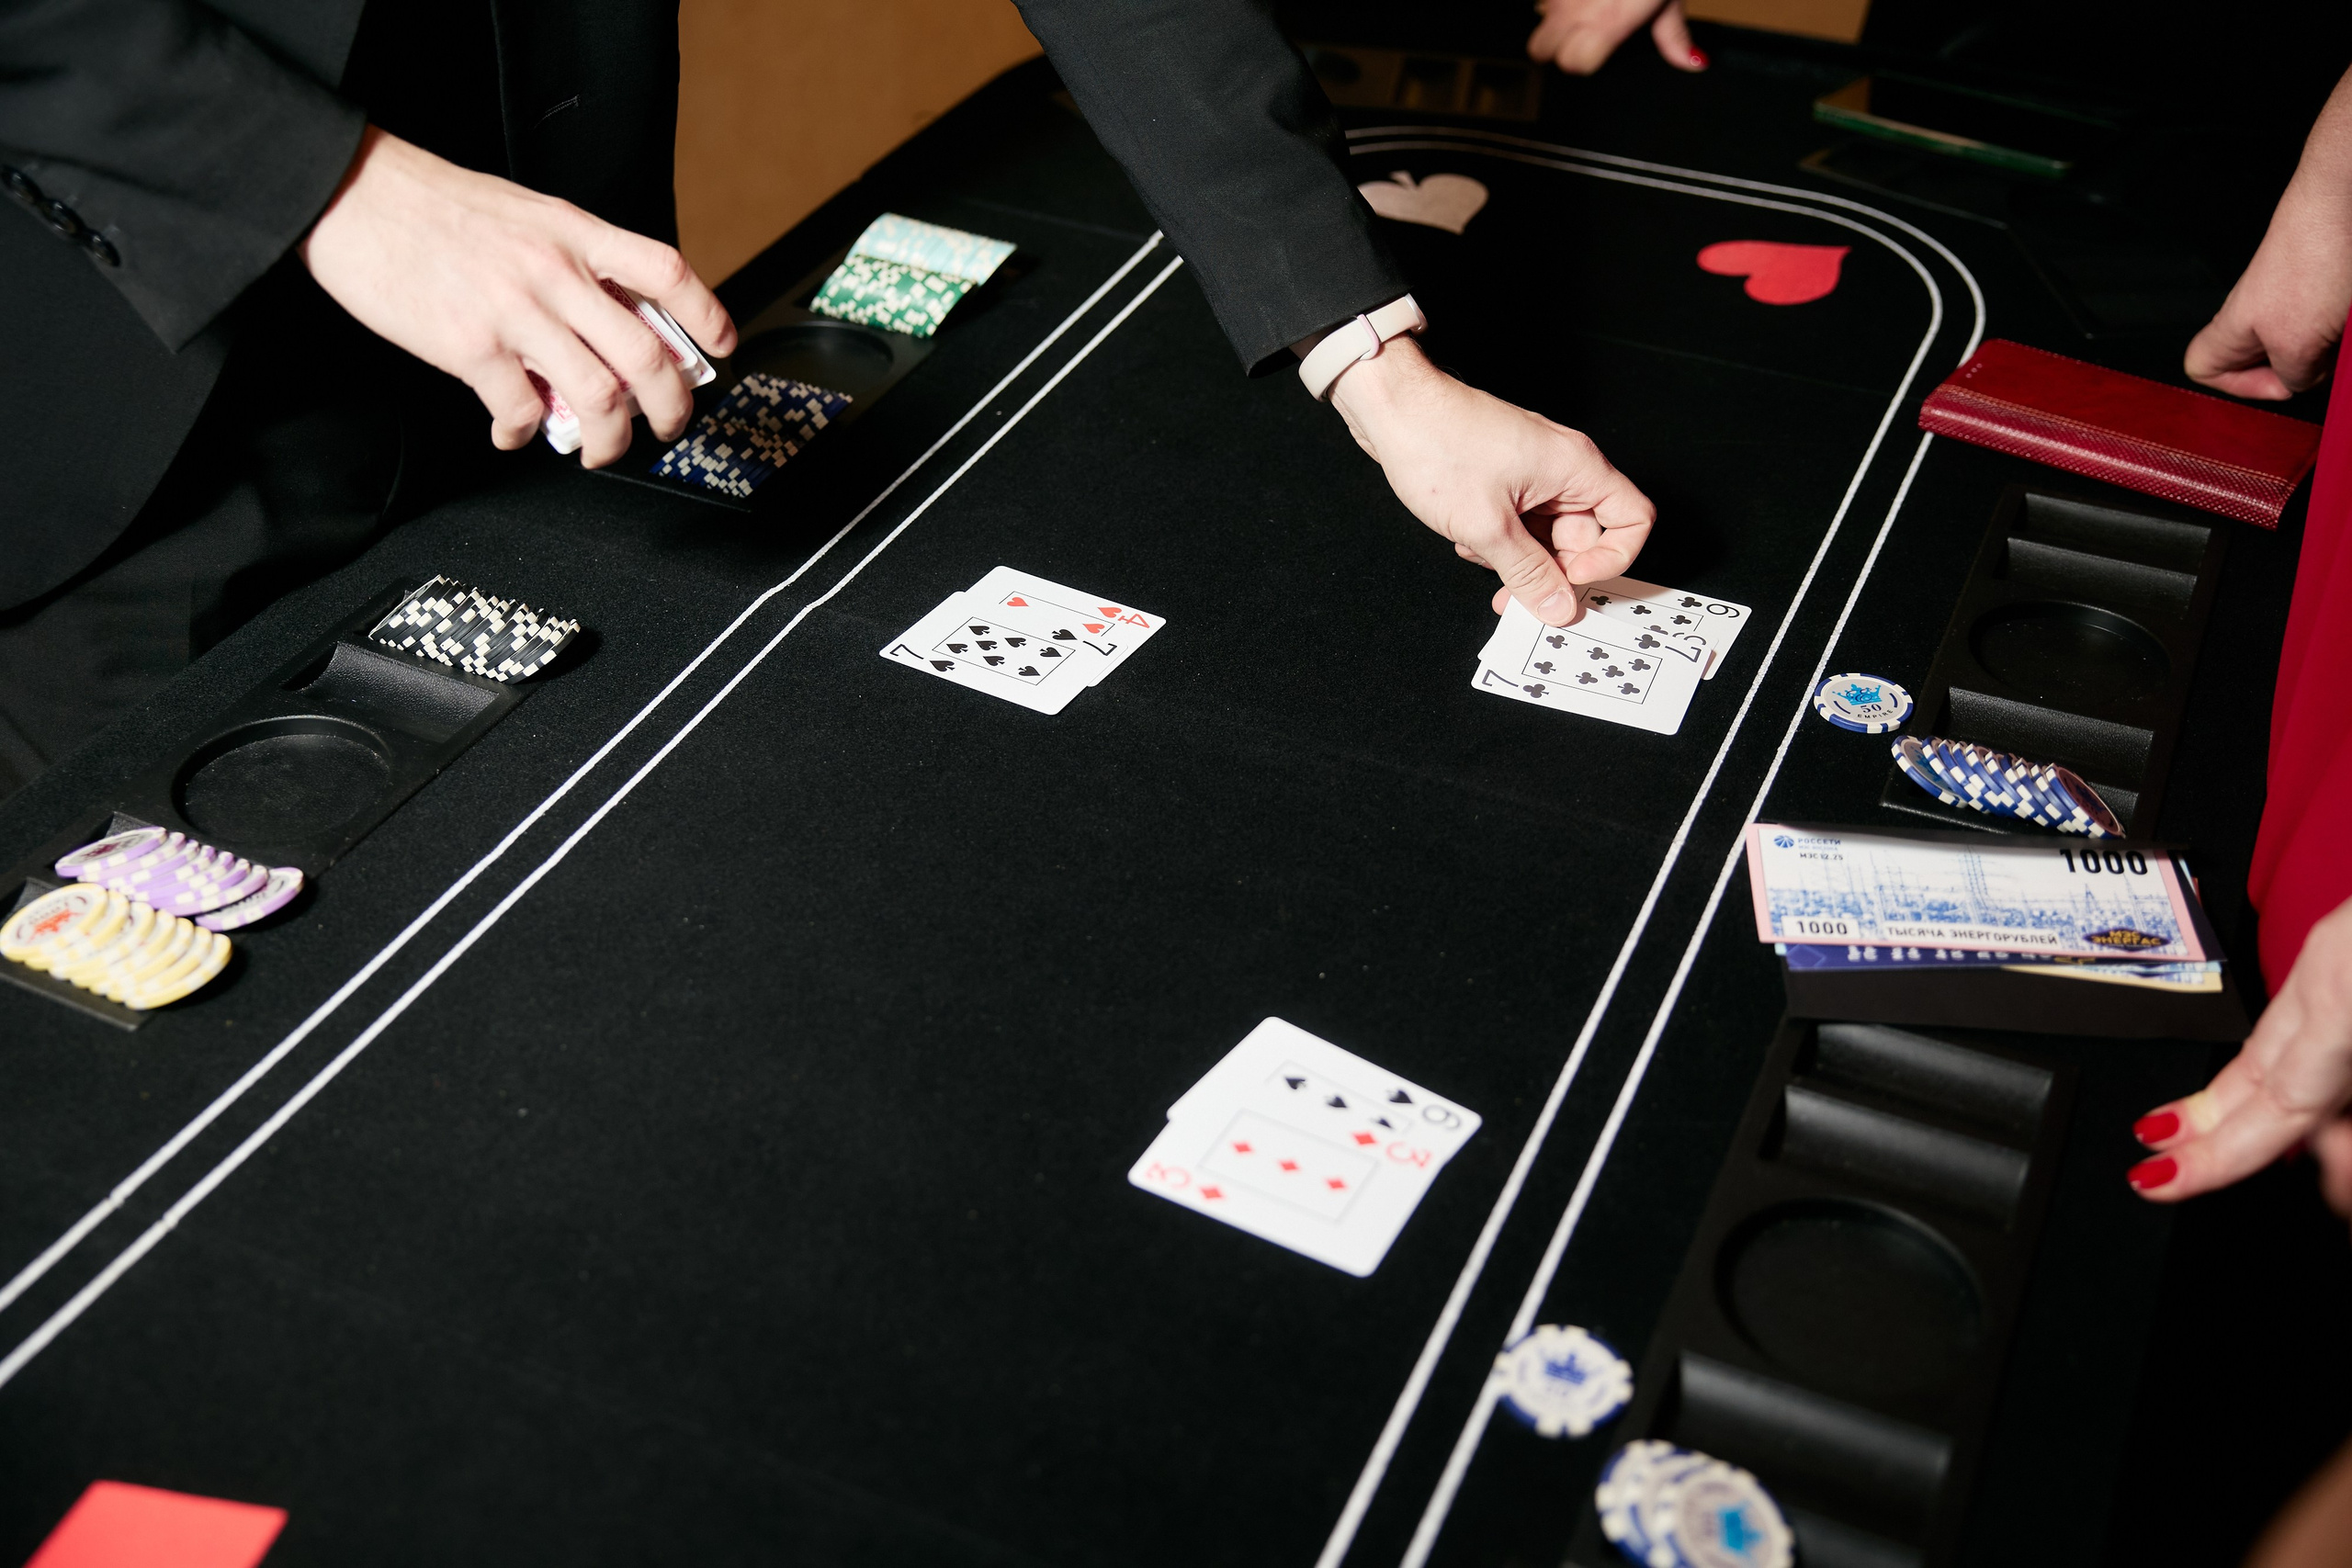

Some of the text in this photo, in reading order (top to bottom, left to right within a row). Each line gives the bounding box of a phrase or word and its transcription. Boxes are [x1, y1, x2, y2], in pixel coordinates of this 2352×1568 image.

[1706, 603, 1740, 619] 6
[1117, 613, 1150, 629] 4
[888, 643, 925, 660] 7
[1082, 640, 1118, 657] 7
[1664, 645, 1702, 663] 7
[1481, 669, 1520, 688] 7
[1857, 709, 1894, 719] EMPIRE
[1860, 704, 1881, 713] 50
[2060, 849, 2148, 875] 1000
[1796, 920, 1849, 935] 1000
[1887, 926, 2058, 945] ТЫСЯЧА ЭНЕРГОРУБЛЕЙ
[1421, 1104, 1462, 1131] 6
[1385, 1141, 1433, 1168] 3
[1143, 1161, 1192, 1190] 3
